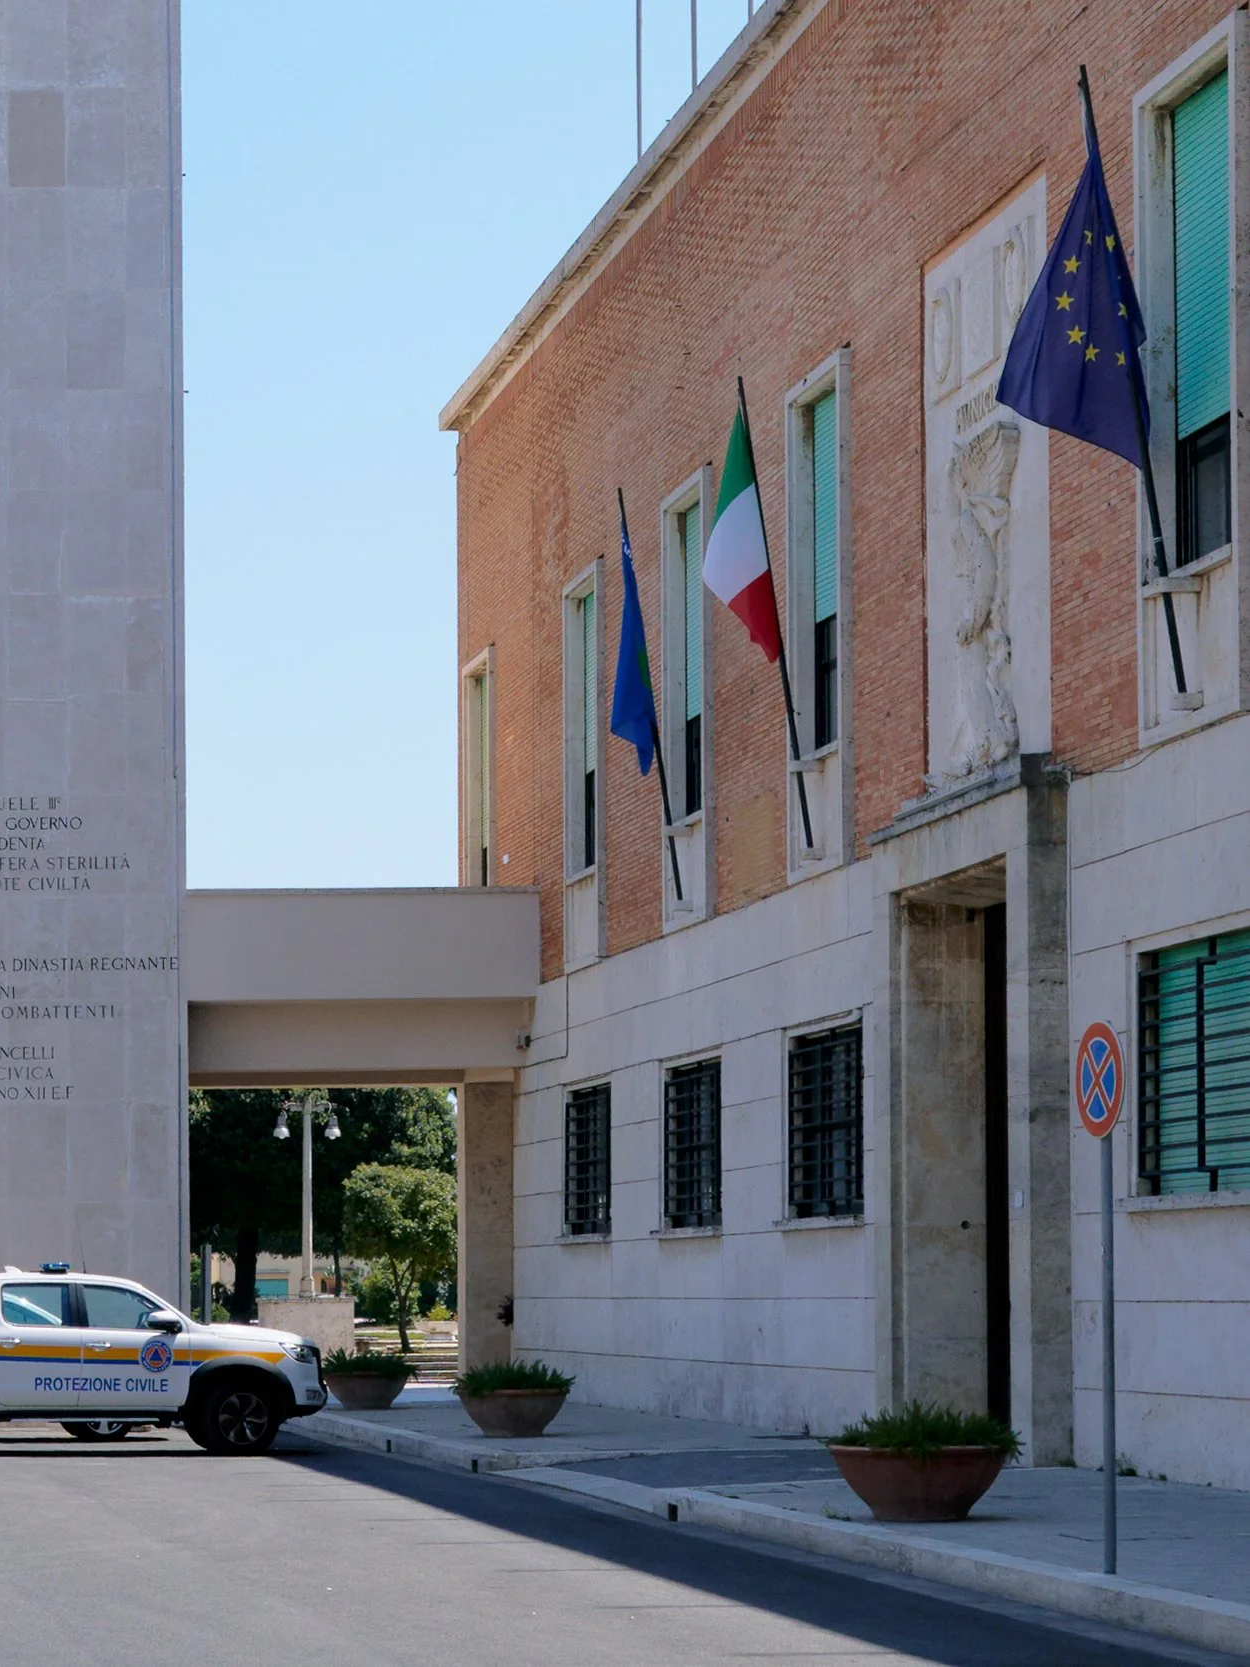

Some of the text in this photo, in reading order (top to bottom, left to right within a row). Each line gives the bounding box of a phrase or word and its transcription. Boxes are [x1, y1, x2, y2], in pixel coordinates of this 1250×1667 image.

[6, 817, 82, 830] GOVERNO
[13, 958, 84, 971] DINASTIA
[90, 957, 178, 971] REGNANTE
[23, 1087, 46, 1100] XII
[35, 1377, 168, 1392] PROTEZIONE CIVILE
